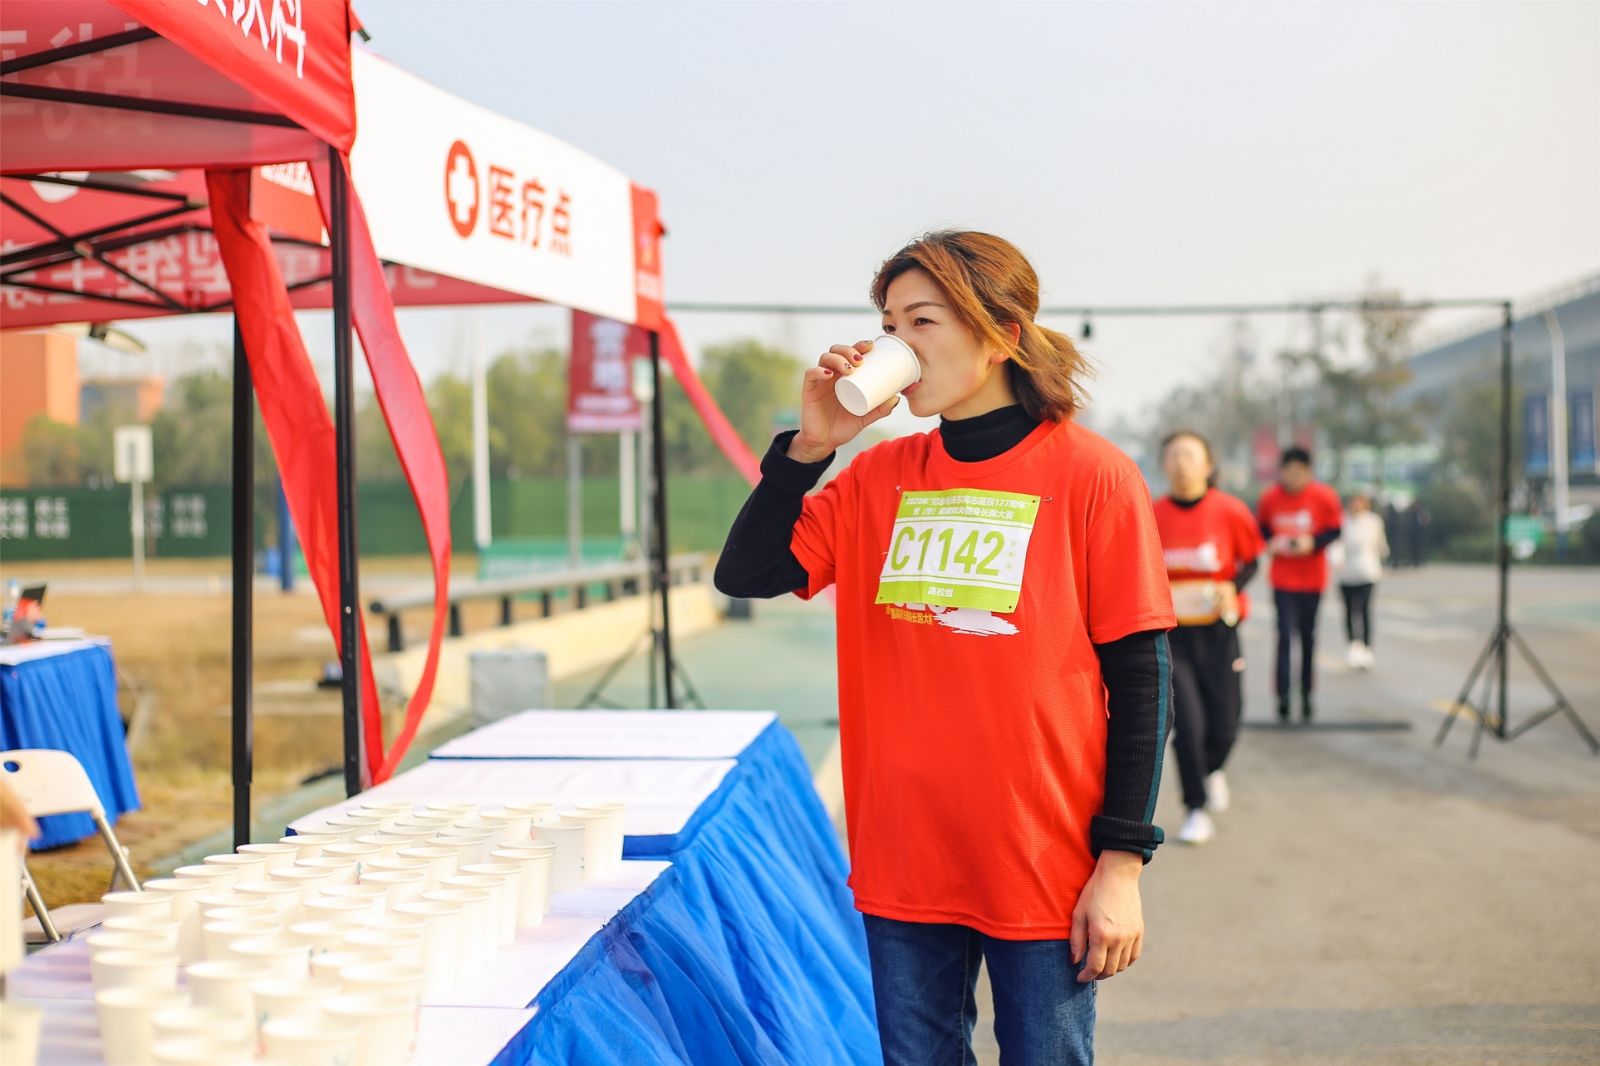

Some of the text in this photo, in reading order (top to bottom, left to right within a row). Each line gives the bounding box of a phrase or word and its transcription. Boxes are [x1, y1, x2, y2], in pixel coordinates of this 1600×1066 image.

[487, 163, 573, 257] 医疗点
[891, 526, 1004, 576] C1142
